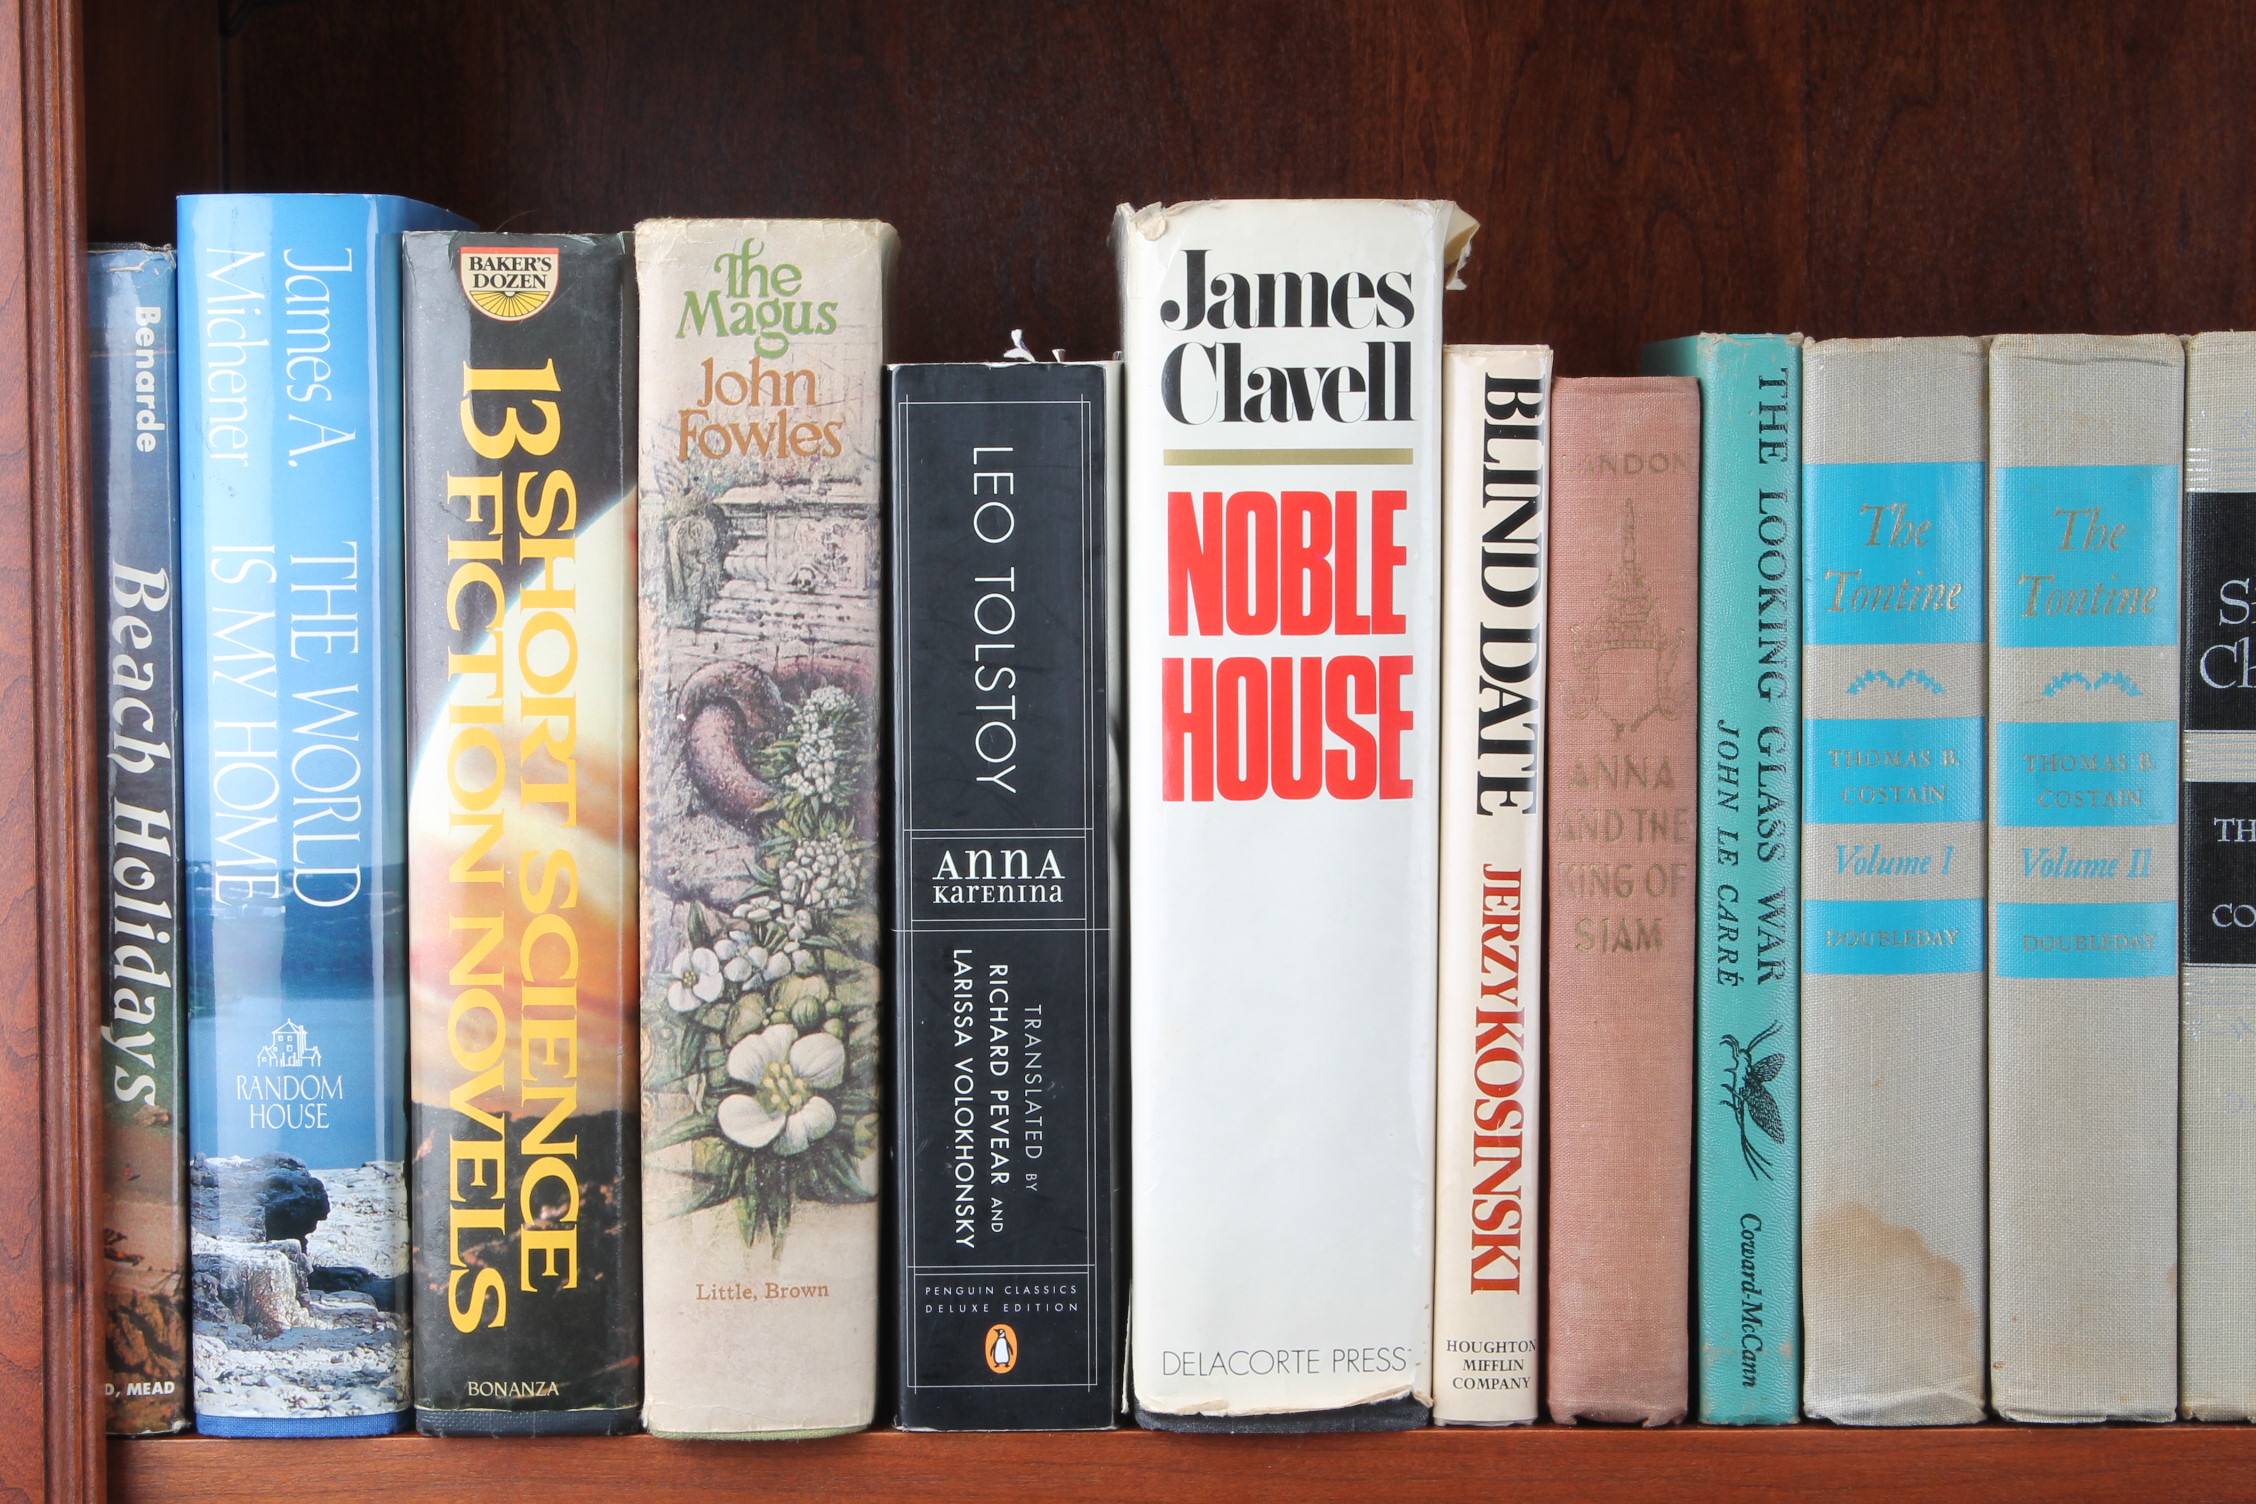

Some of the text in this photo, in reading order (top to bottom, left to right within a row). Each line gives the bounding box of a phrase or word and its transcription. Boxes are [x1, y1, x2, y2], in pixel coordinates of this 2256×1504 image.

[468, 254, 553, 272] BAKER'S
[473, 272, 547, 290] DOZEN
[713, 236, 802, 299] The
[1160, 249, 1416, 331] James
[675, 290, 837, 358] Magus
[134, 306, 166, 453] Benarde
[205, 247, 269, 468] Michener
[283, 247, 357, 468] James A.
[697, 357, 817, 407] John
[1161, 341, 1417, 425] Clavell
[678, 408, 843, 460] Fowles
[1860, 503, 1933, 547] The
[2054, 507, 2127, 551] The
[1167, 490, 1408, 637] NOBLE
[1477, 372, 1547, 815] BLIND DATE
[1824, 568, 1963, 613] Tontine
[2018, 574, 2159, 618] Tontine
[972, 446, 1017, 794] LEO TOLSTOY
[1757, 368, 1788, 985] THE LOOKING GLASS WAR
[210, 544, 280, 906] IS MY HOME
[290, 540, 362, 907] THE WORLD
[1161, 655, 1414, 802] HOUSE
[1570, 755, 1675, 790] ANNA
[1828, 748, 1961, 768] THOMAS B.
[2023, 751, 2157, 772] THOMAS B.
[1842, 784, 1947, 804] COSTAIN
[2038, 788, 2143, 808] COSTAIN
[101, 558, 172, 1106] Beach Holidays
[460, 358, 580, 1292] 13 SHORT SCIENCE
[1557, 808, 1690, 844] AND THE
[1716, 719, 1740, 987] JOHN LE CARRÉ
[1835, 845, 1955, 876] Volume I
[2021, 848, 2153, 879] Volume II
[1557, 862, 1688, 898] KING OF
[446, 471, 507, 1334] FICTION NOVELS
[1576, 917, 1663, 953] SIAM
[1826, 930, 1960, 948] DOUBLEDAY
[2022, 933, 2157, 952] DOUBLEDAY
[235, 1074, 344, 1100] RANDOM
[953, 948, 975, 1249] LARISSA VOLOKHONSKY
[988, 964, 1010, 1233] RICHARD PEVEAR AND
[1023, 1004, 1043, 1192] TRANSLATED BY
[1470, 863, 1525, 1296] JERZY KOSINSKI
[249, 1103, 330, 1130] HOUSE
[695, 1280, 829, 1301] Little, Brown
[925, 1285, 1078, 1296] PENGUIN CLASSICS
[926, 1302, 1079, 1313] DELUXE EDITION
[1739, 1213, 1763, 1388] Coward-McCann
[1162, 1346, 1408, 1377] DELACORTE PRESS
[1446, 1339, 1536, 1354] HOUGHTON
[1463, 1359, 1524, 1372] MIFFLIN
[126, 1381, 175, 1396] MEAD
[467, 1381, 559, 1397] BONANZA
[1452, 1377, 1531, 1391] COMPANY
